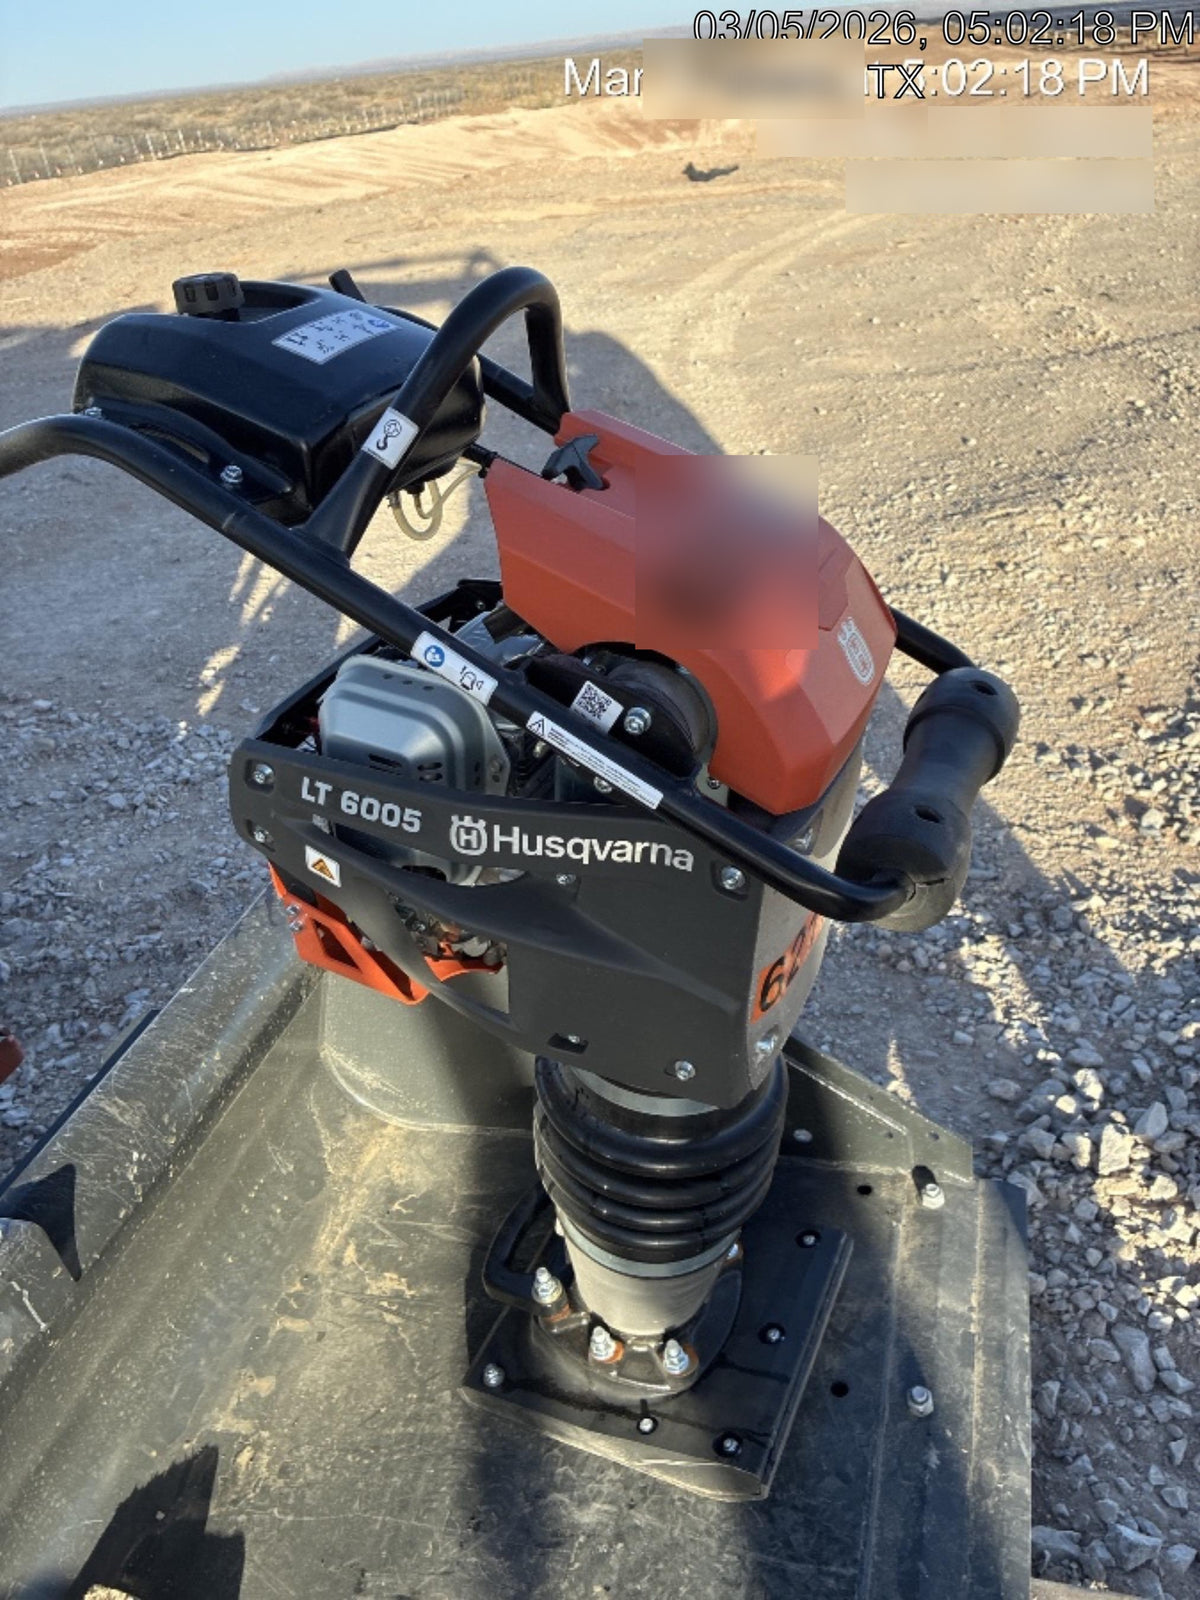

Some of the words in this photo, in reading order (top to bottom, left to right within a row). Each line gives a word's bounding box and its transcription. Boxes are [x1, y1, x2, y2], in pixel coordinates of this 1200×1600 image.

[301, 776, 333, 806] LT
[341, 790, 423, 833] 6005
[492, 824, 695, 873] Husqvarna
